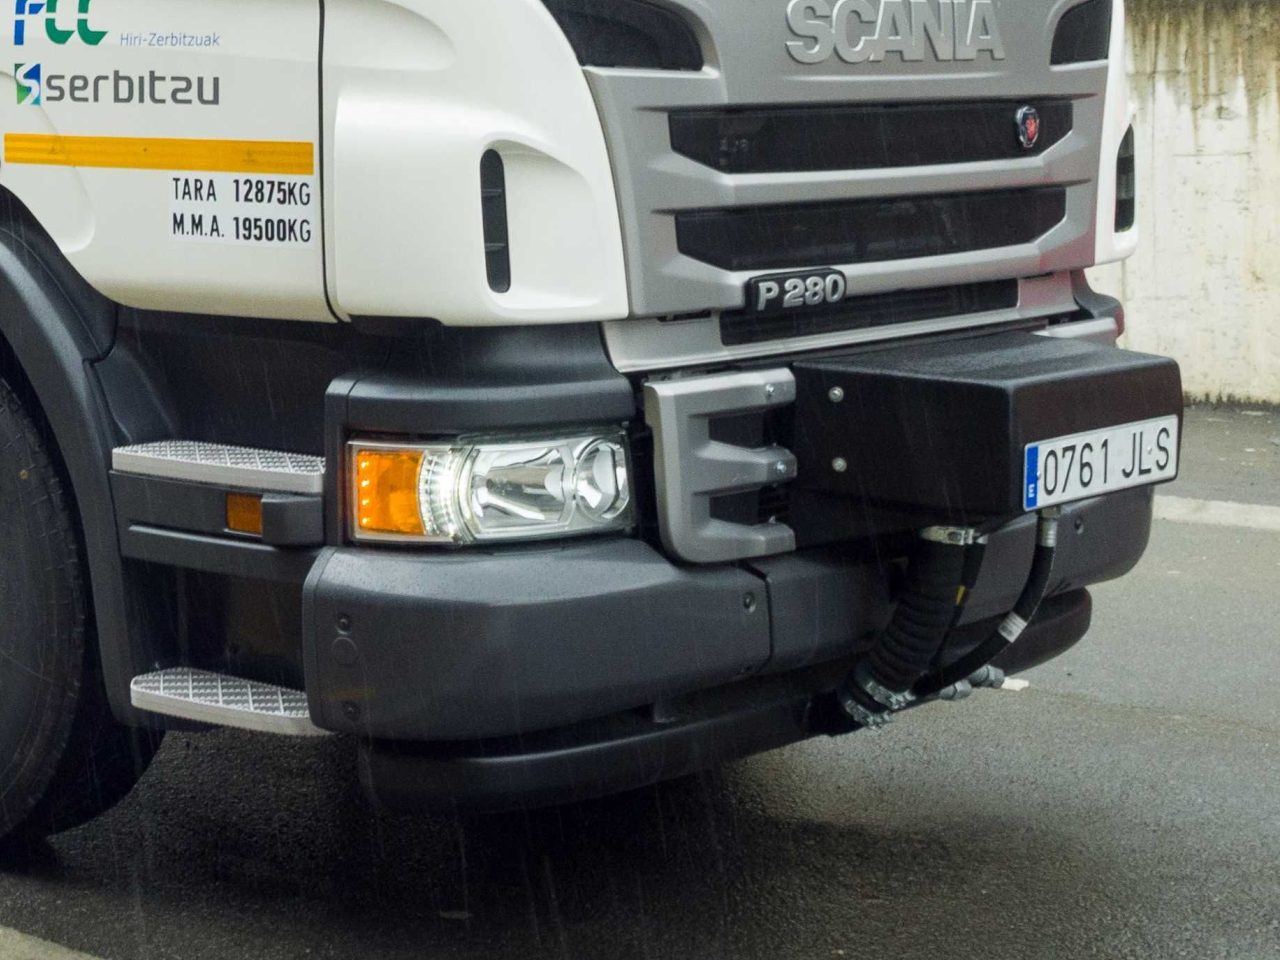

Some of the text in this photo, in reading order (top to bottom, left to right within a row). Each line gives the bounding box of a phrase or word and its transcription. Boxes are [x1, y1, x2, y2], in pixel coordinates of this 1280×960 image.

[119, 32, 220, 47] Hiri-Zerbitzuak
[45, 70, 220, 106] serbitzu
[172, 177, 311, 206] TARA 12875KG
[172, 212, 312, 243] M.M.A. 19500KG
[756, 273, 846, 311] P 280
[1043, 426, 1171, 496] 0761 JLS
